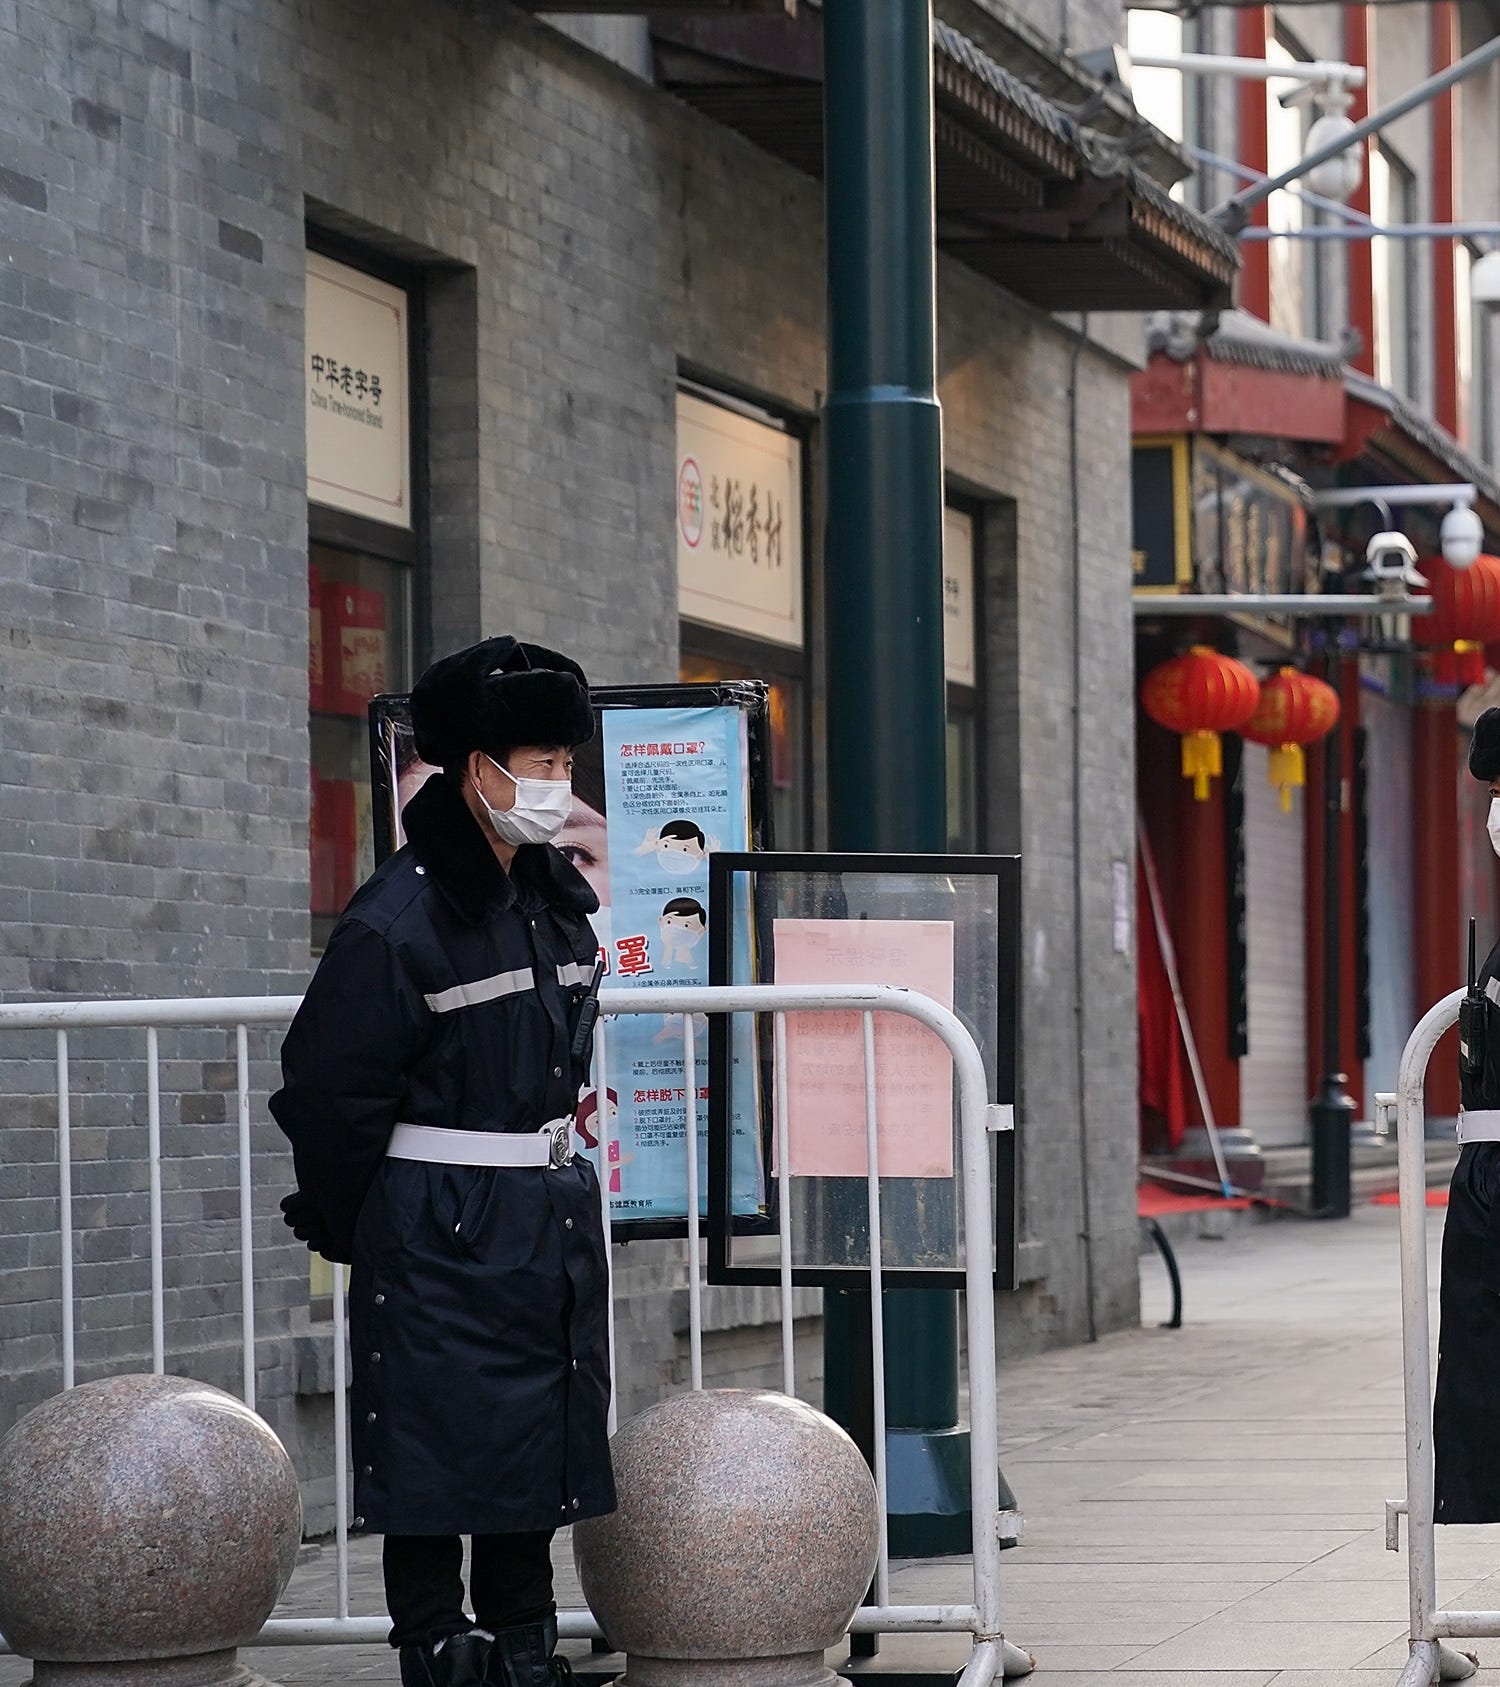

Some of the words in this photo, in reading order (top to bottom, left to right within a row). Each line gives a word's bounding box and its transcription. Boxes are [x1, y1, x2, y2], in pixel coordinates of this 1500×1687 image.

[311, 353, 382, 406] 中华老字号
[633, 1087, 709, 1103] 怎样脱下罩
